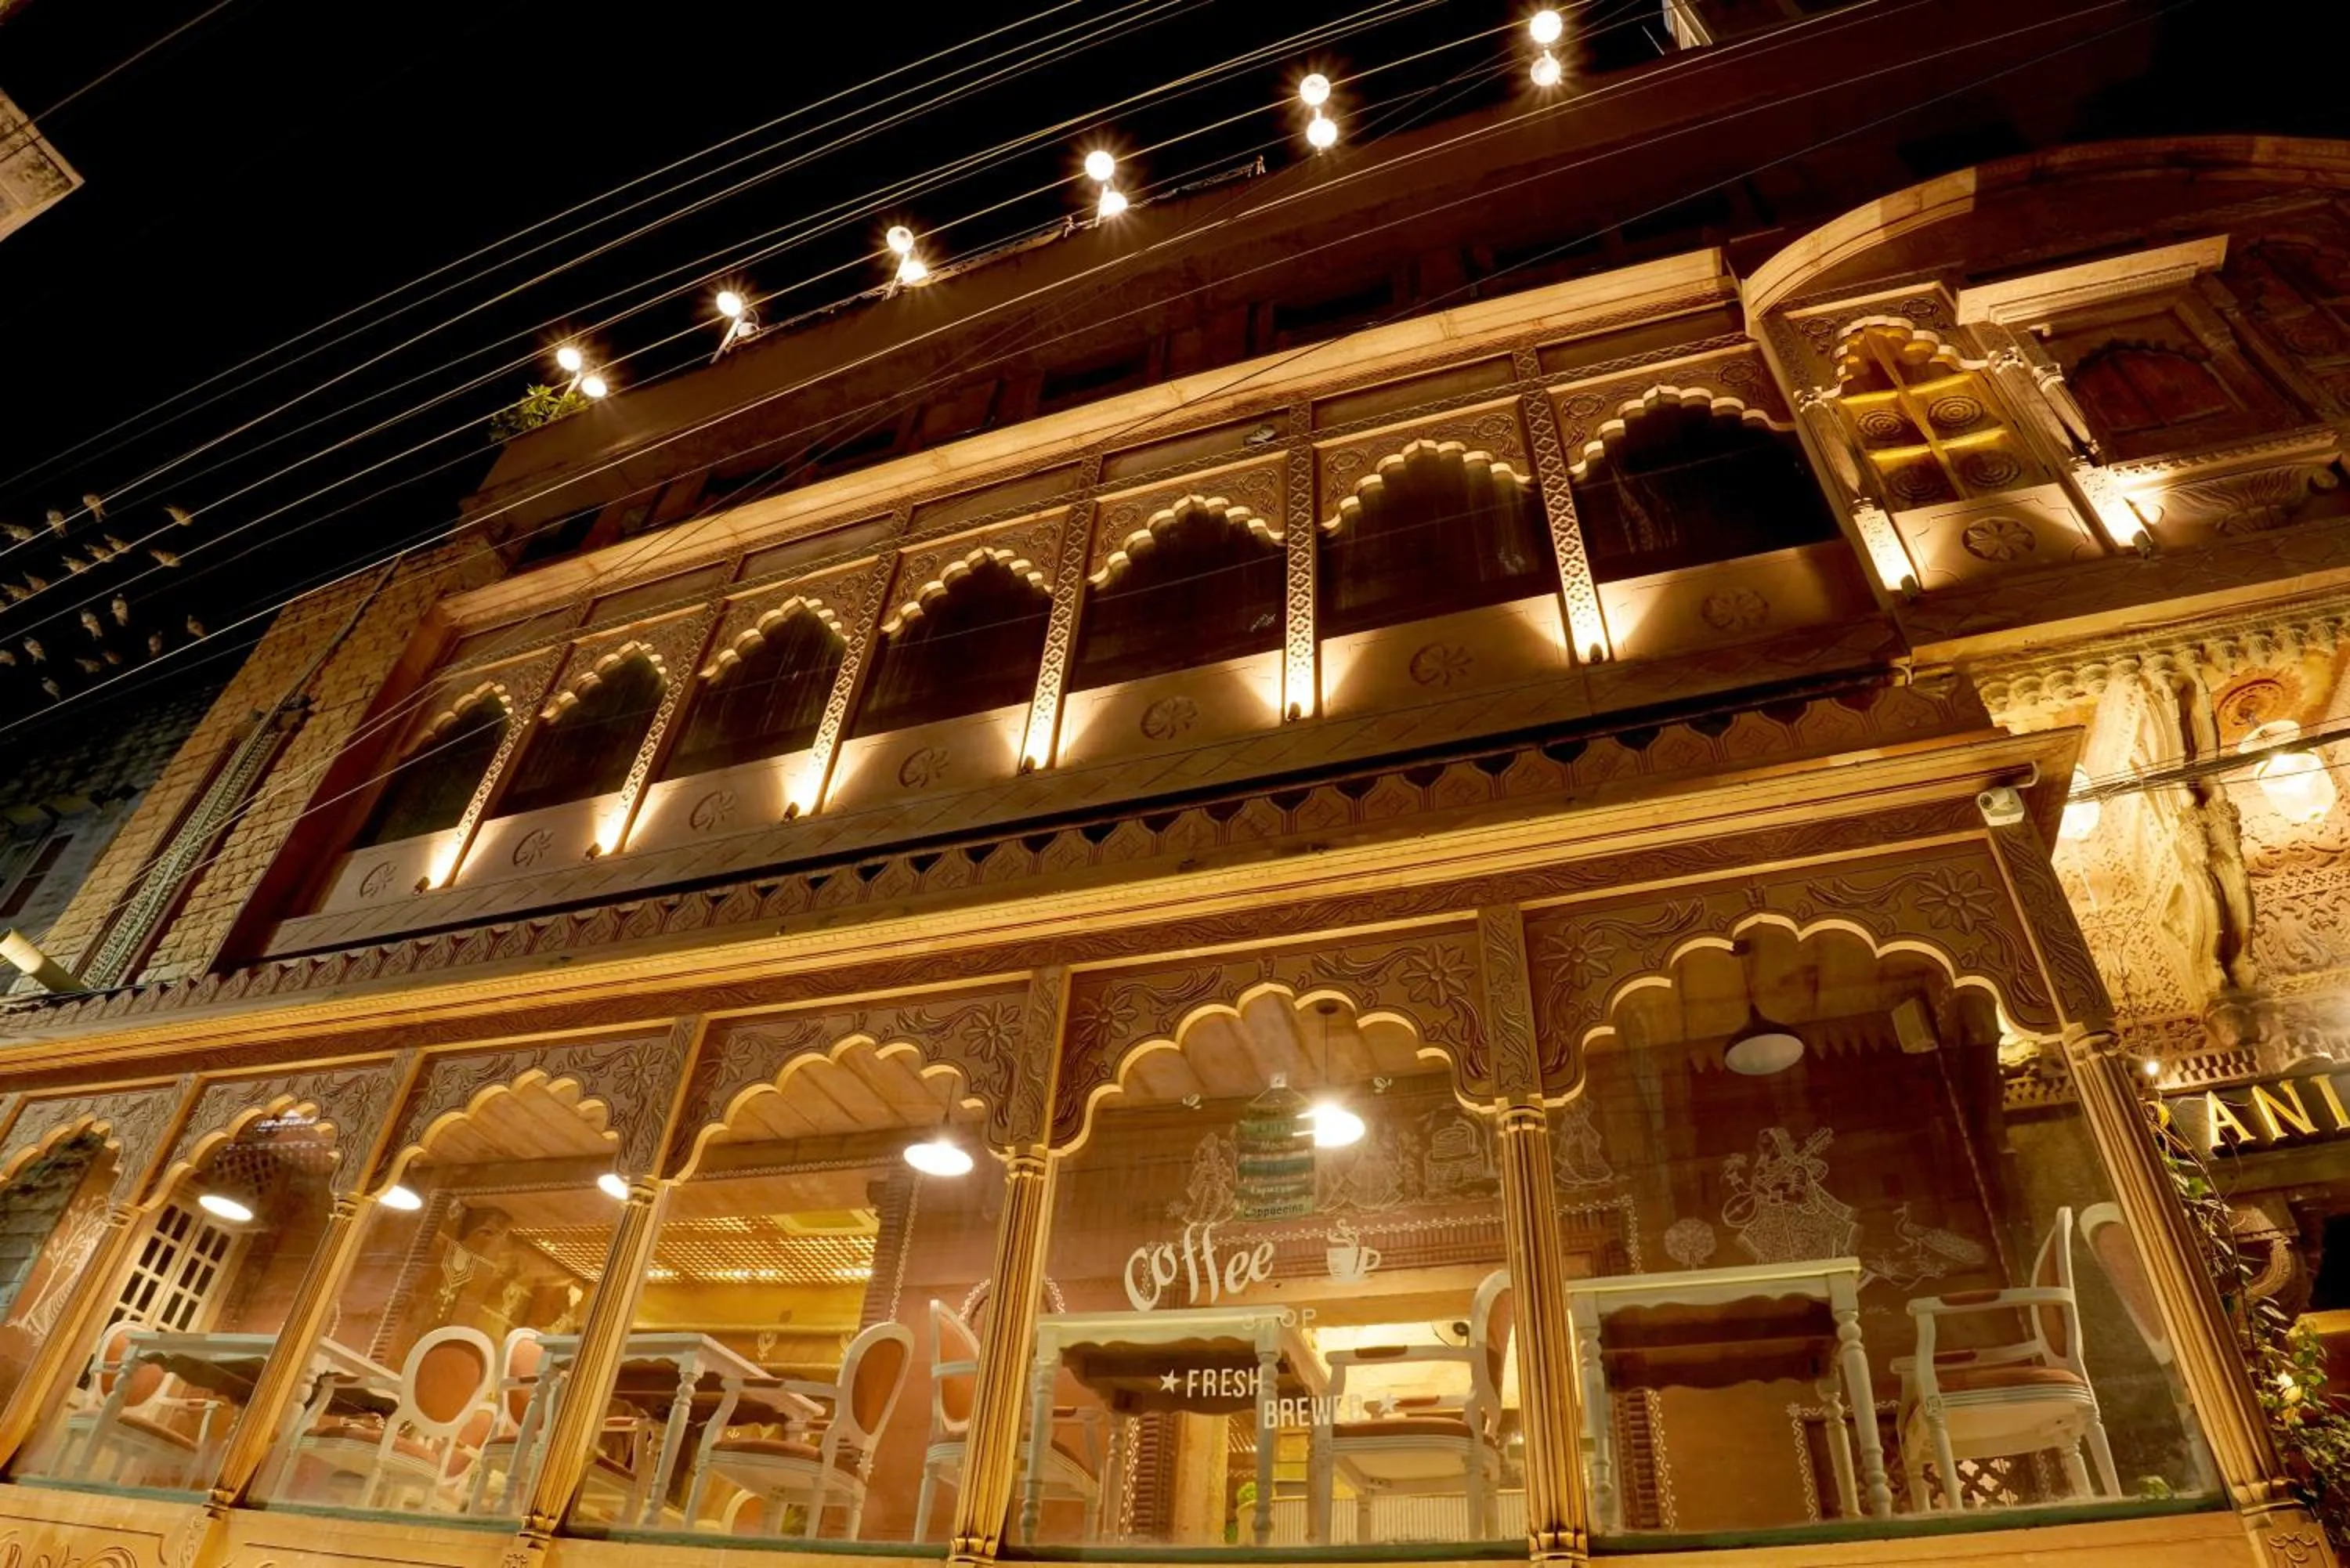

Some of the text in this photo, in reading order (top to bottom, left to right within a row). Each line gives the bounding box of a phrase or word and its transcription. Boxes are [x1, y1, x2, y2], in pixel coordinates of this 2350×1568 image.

[2206, 1075, 2350, 1150] ANI
[1125, 1222, 1274, 1310] Coffee
[1242, 1309, 1317, 1331] SHOP
[1187, 1367, 1263, 1398] FRESH
